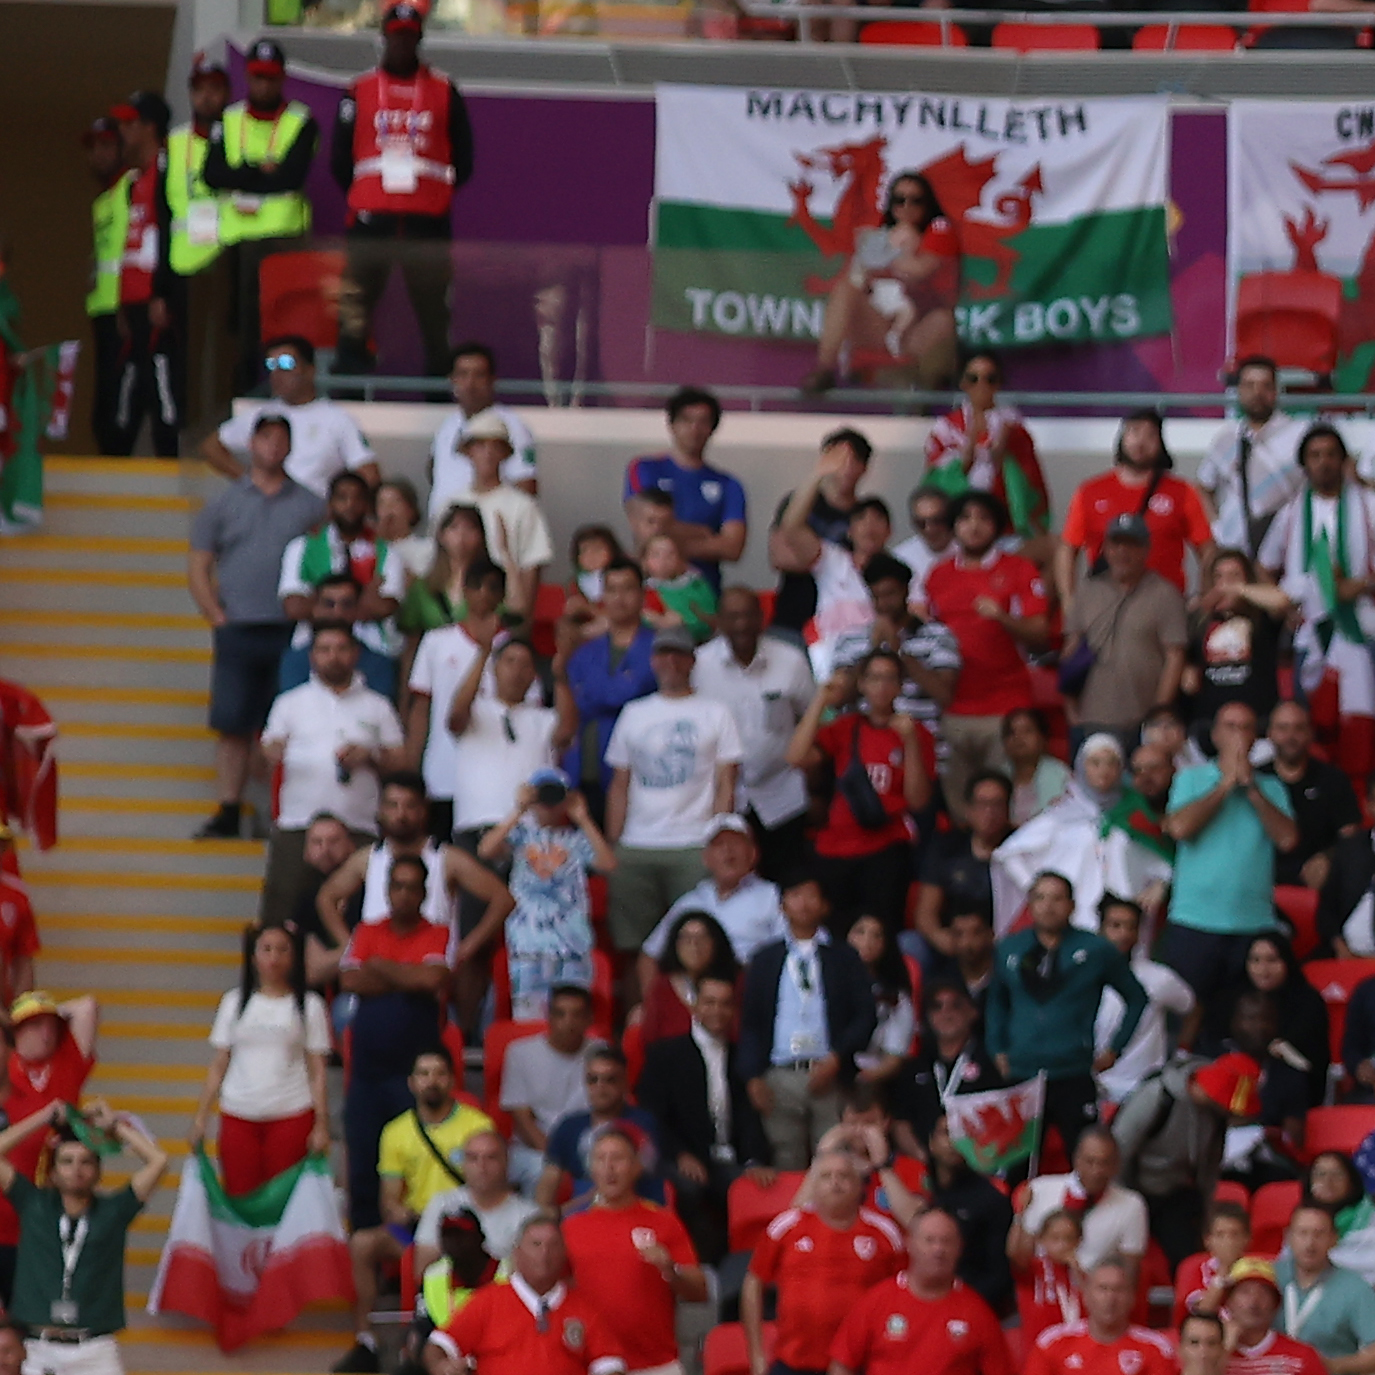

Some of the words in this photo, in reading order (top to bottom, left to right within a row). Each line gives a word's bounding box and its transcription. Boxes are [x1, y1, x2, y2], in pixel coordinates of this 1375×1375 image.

[746, 91, 1089, 142] MACHYNLLETH
[685, 286, 824, 337] TOWN
[1013, 293, 1142, 337] BOYS
